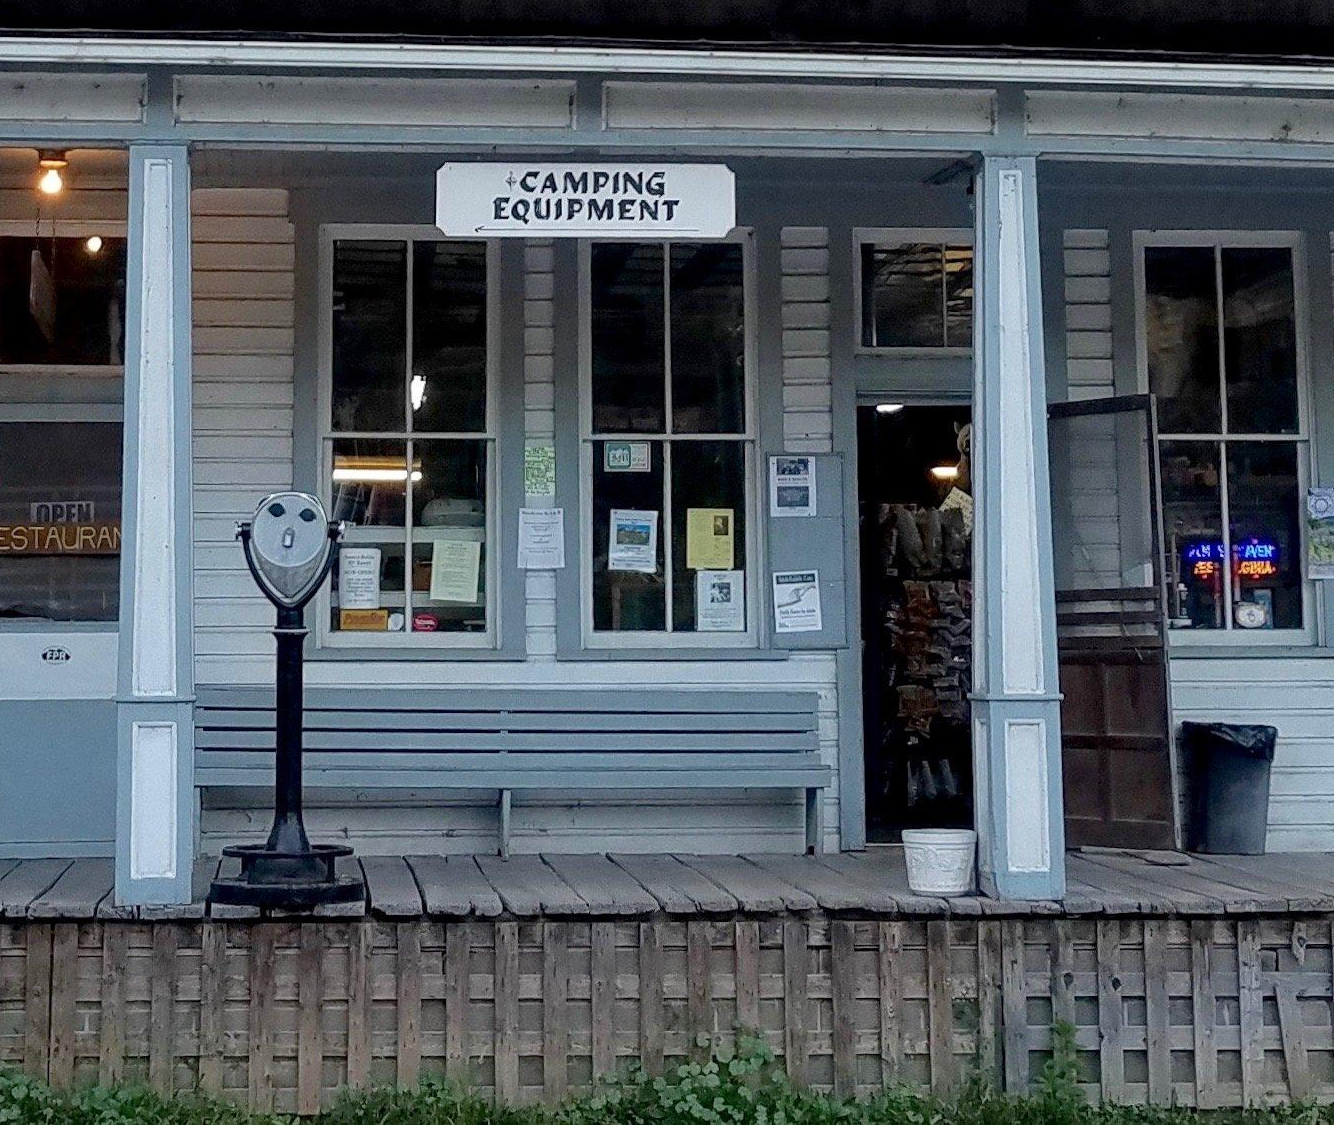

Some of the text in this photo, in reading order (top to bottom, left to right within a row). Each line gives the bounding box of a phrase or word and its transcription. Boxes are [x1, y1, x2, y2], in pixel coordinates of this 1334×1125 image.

[519, 171, 666, 197] CAMPING
[492, 196, 680, 224] EQUIPMENT
[36, 503, 92, 523] OPEN
